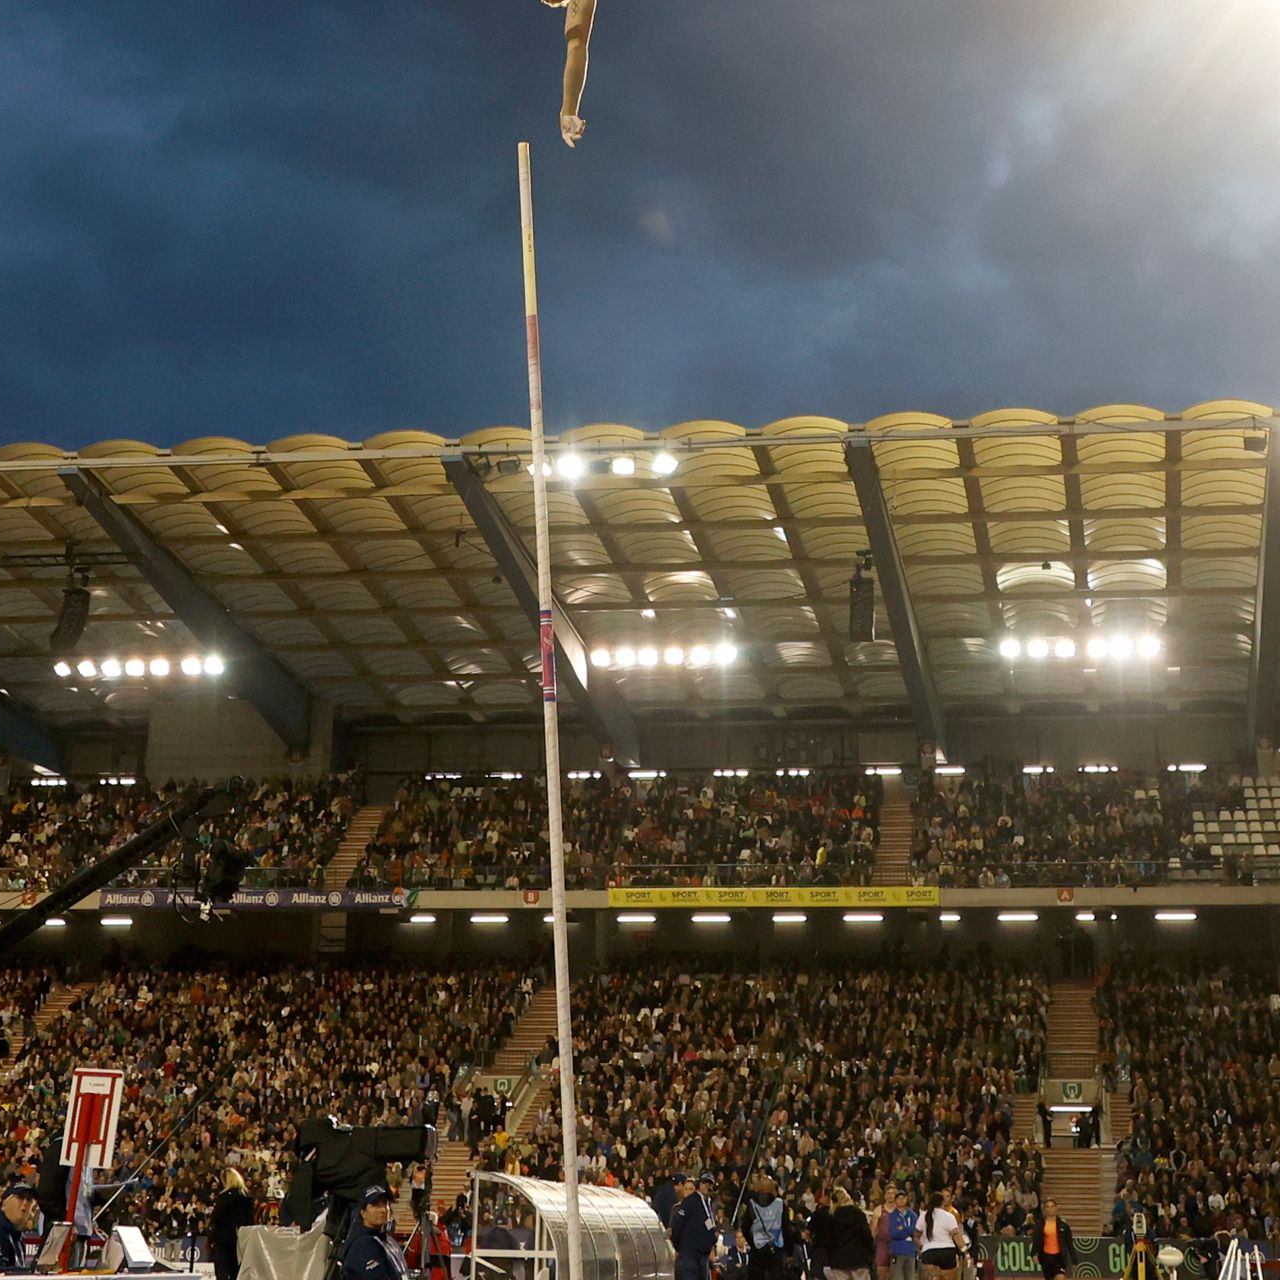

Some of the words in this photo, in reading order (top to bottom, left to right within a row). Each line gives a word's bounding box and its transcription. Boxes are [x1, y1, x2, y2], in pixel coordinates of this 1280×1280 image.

[104, 892, 140, 904] Allianz
[229, 893, 264, 904] Allianz
[291, 892, 327, 904] Allianz
[354, 892, 391, 904] Allianz
[527, 892, 534, 902] B
[1061, 890, 1070, 900] A
